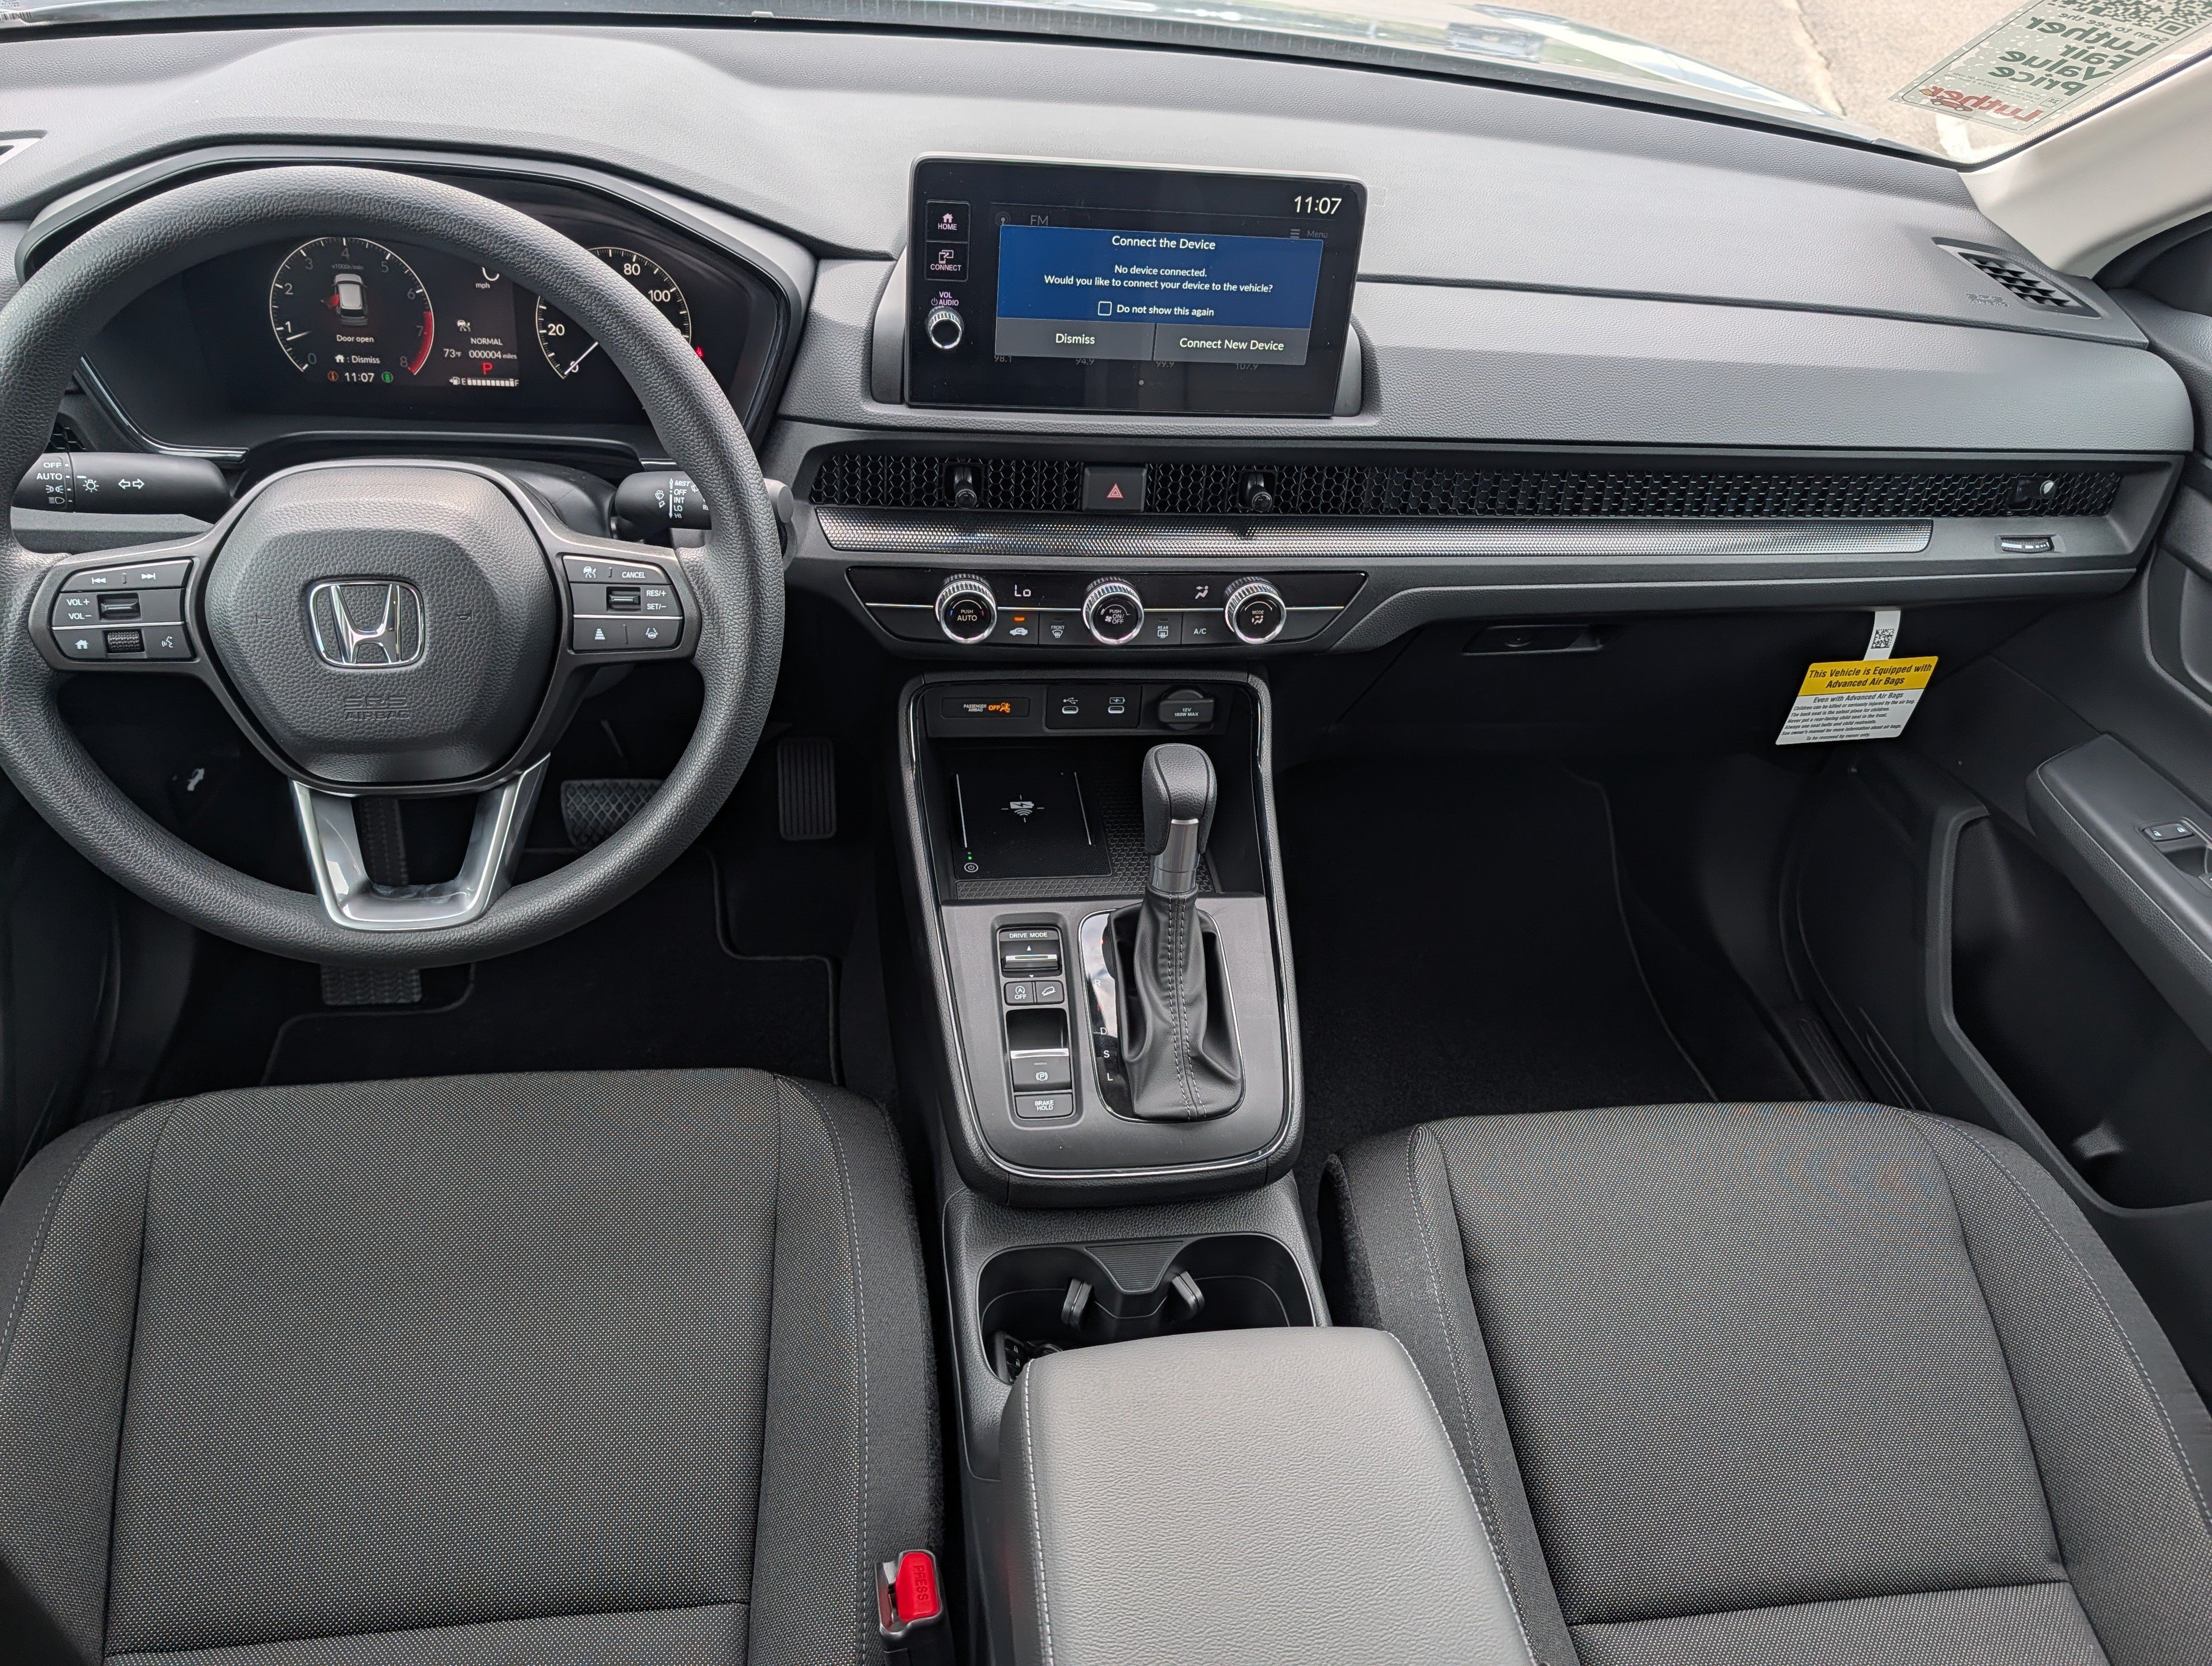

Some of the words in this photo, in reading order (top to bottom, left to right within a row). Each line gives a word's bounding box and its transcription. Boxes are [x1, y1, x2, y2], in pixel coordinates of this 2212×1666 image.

[1295, 196, 1342, 214] 11:07
[1030, 215, 1049, 226] FM
[1307, 230, 1328, 238] Menu
[1112, 235, 1156, 247] Connect
[1159, 238, 1176, 248] the
[1179, 238, 1216, 249] Device
[341, 248, 349, 260] 4
[305, 258, 313, 270] 3
[381, 261, 389, 273] 5
[623, 263, 640, 275] 80
[1115, 264, 1128, 273] No
[1130, 265, 1158, 275] device
[1160, 267, 1207, 277] connected.
[285, 283, 293, 295] 2
[1044, 274, 1073, 284] Would
[1076, 278, 1092, 286] you
[1095, 277, 1110, 286] like
[1112, 278, 1121, 286] to
[1123, 279, 1158, 288] connect
[1160, 281, 1180, 290] your
[1182, 280, 1210, 290] device
[1212, 283, 1221, 291] to
[1223, 282, 1237, 291] the
[1239, 283, 1273, 292] vehicle?
[407, 291, 415, 299] 6
[648, 289, 671, 302] 100
[1117, 304, 1130, 313] Do
[1149, 305, 1172, 315] show
[1174, 306, 1189, 315] this
[1192, 307, 1214, 317] again
[285, 321, 291, 333] 1
[548, 323, 565, 336] 20
[471, 337, 503, 345] NORMAL
[1056, 333, 1095, 344] Dismiss
[1180, 338, 1221, 349] Connect
[1224, 339, 1248, 349] New
[1250, 340, 1284, 350] Device
[308, 353, 317, 364] 0
[351, 356, 380, 364] Dismiss
[468, 350, 501, 359] 000004
[400, 356, 408, 368] 8
[482, 362, 493, 375] P
[344, 373, 375, 382] 11:07
[1014, 584, 1031, 597] Lo
[1809, 670, 1827, 678] This
[1830, 668, 1861, 677] Vehicle
[1863, 667, 1871, 675] is
[1873, 665, 1912, 675] Equipped
[1914, 663, 1932, 672] with
[1825, 679, 1867, 688] Advanced
[1869, 678, 1882, 686] Air
[1883, 677, 1905, 685] Bags
[1100, 1027, 1108, 1035] D
[1107, 1073, 1114, 1081] L
[913, 1565, 929, 1600] PRESS
